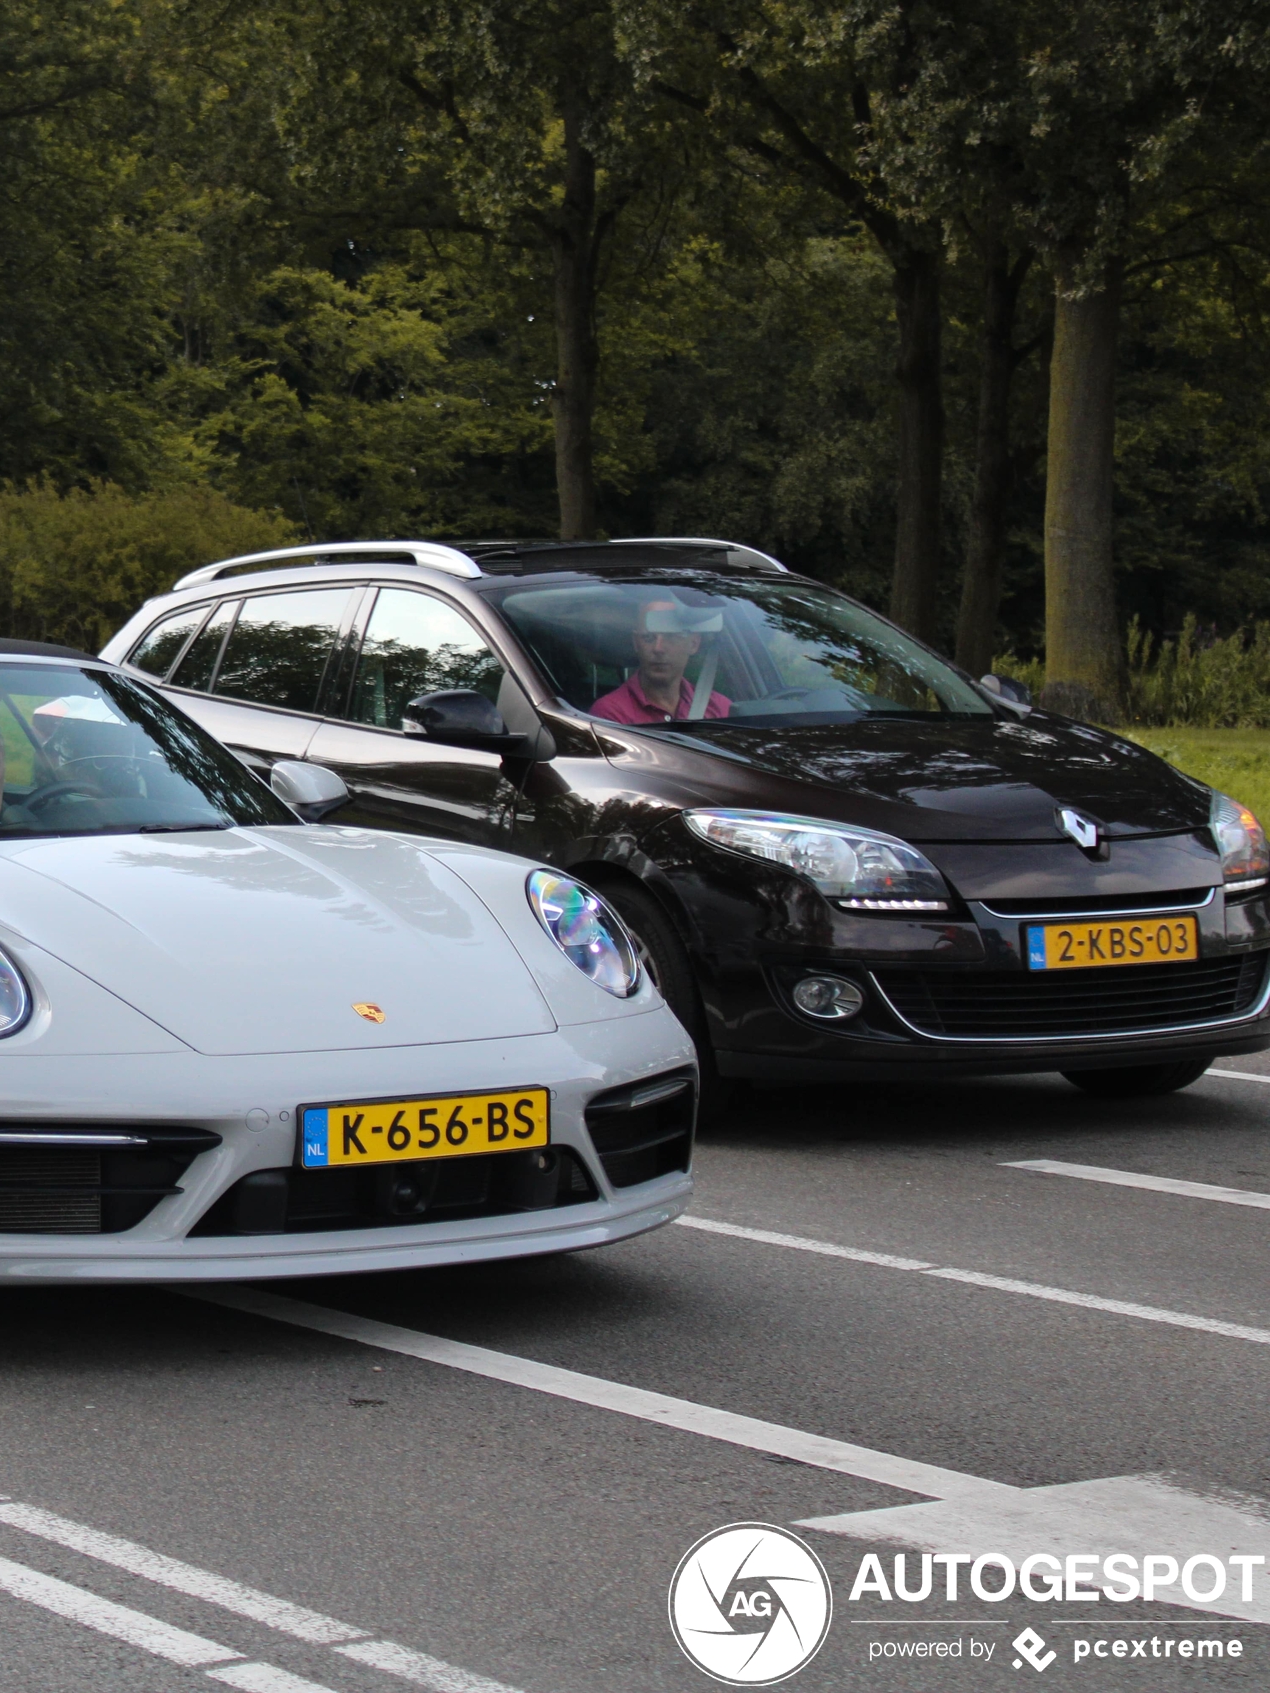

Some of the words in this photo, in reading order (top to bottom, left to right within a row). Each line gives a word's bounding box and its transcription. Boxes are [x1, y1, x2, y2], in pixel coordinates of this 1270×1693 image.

[1058, 923, 1189, 962] 2-KBS-03
[1030, 952, 1045, 963] NL
[342, 1099, 535, 1155] K-656-BS
[307, 1143, 325, 1157] NL
